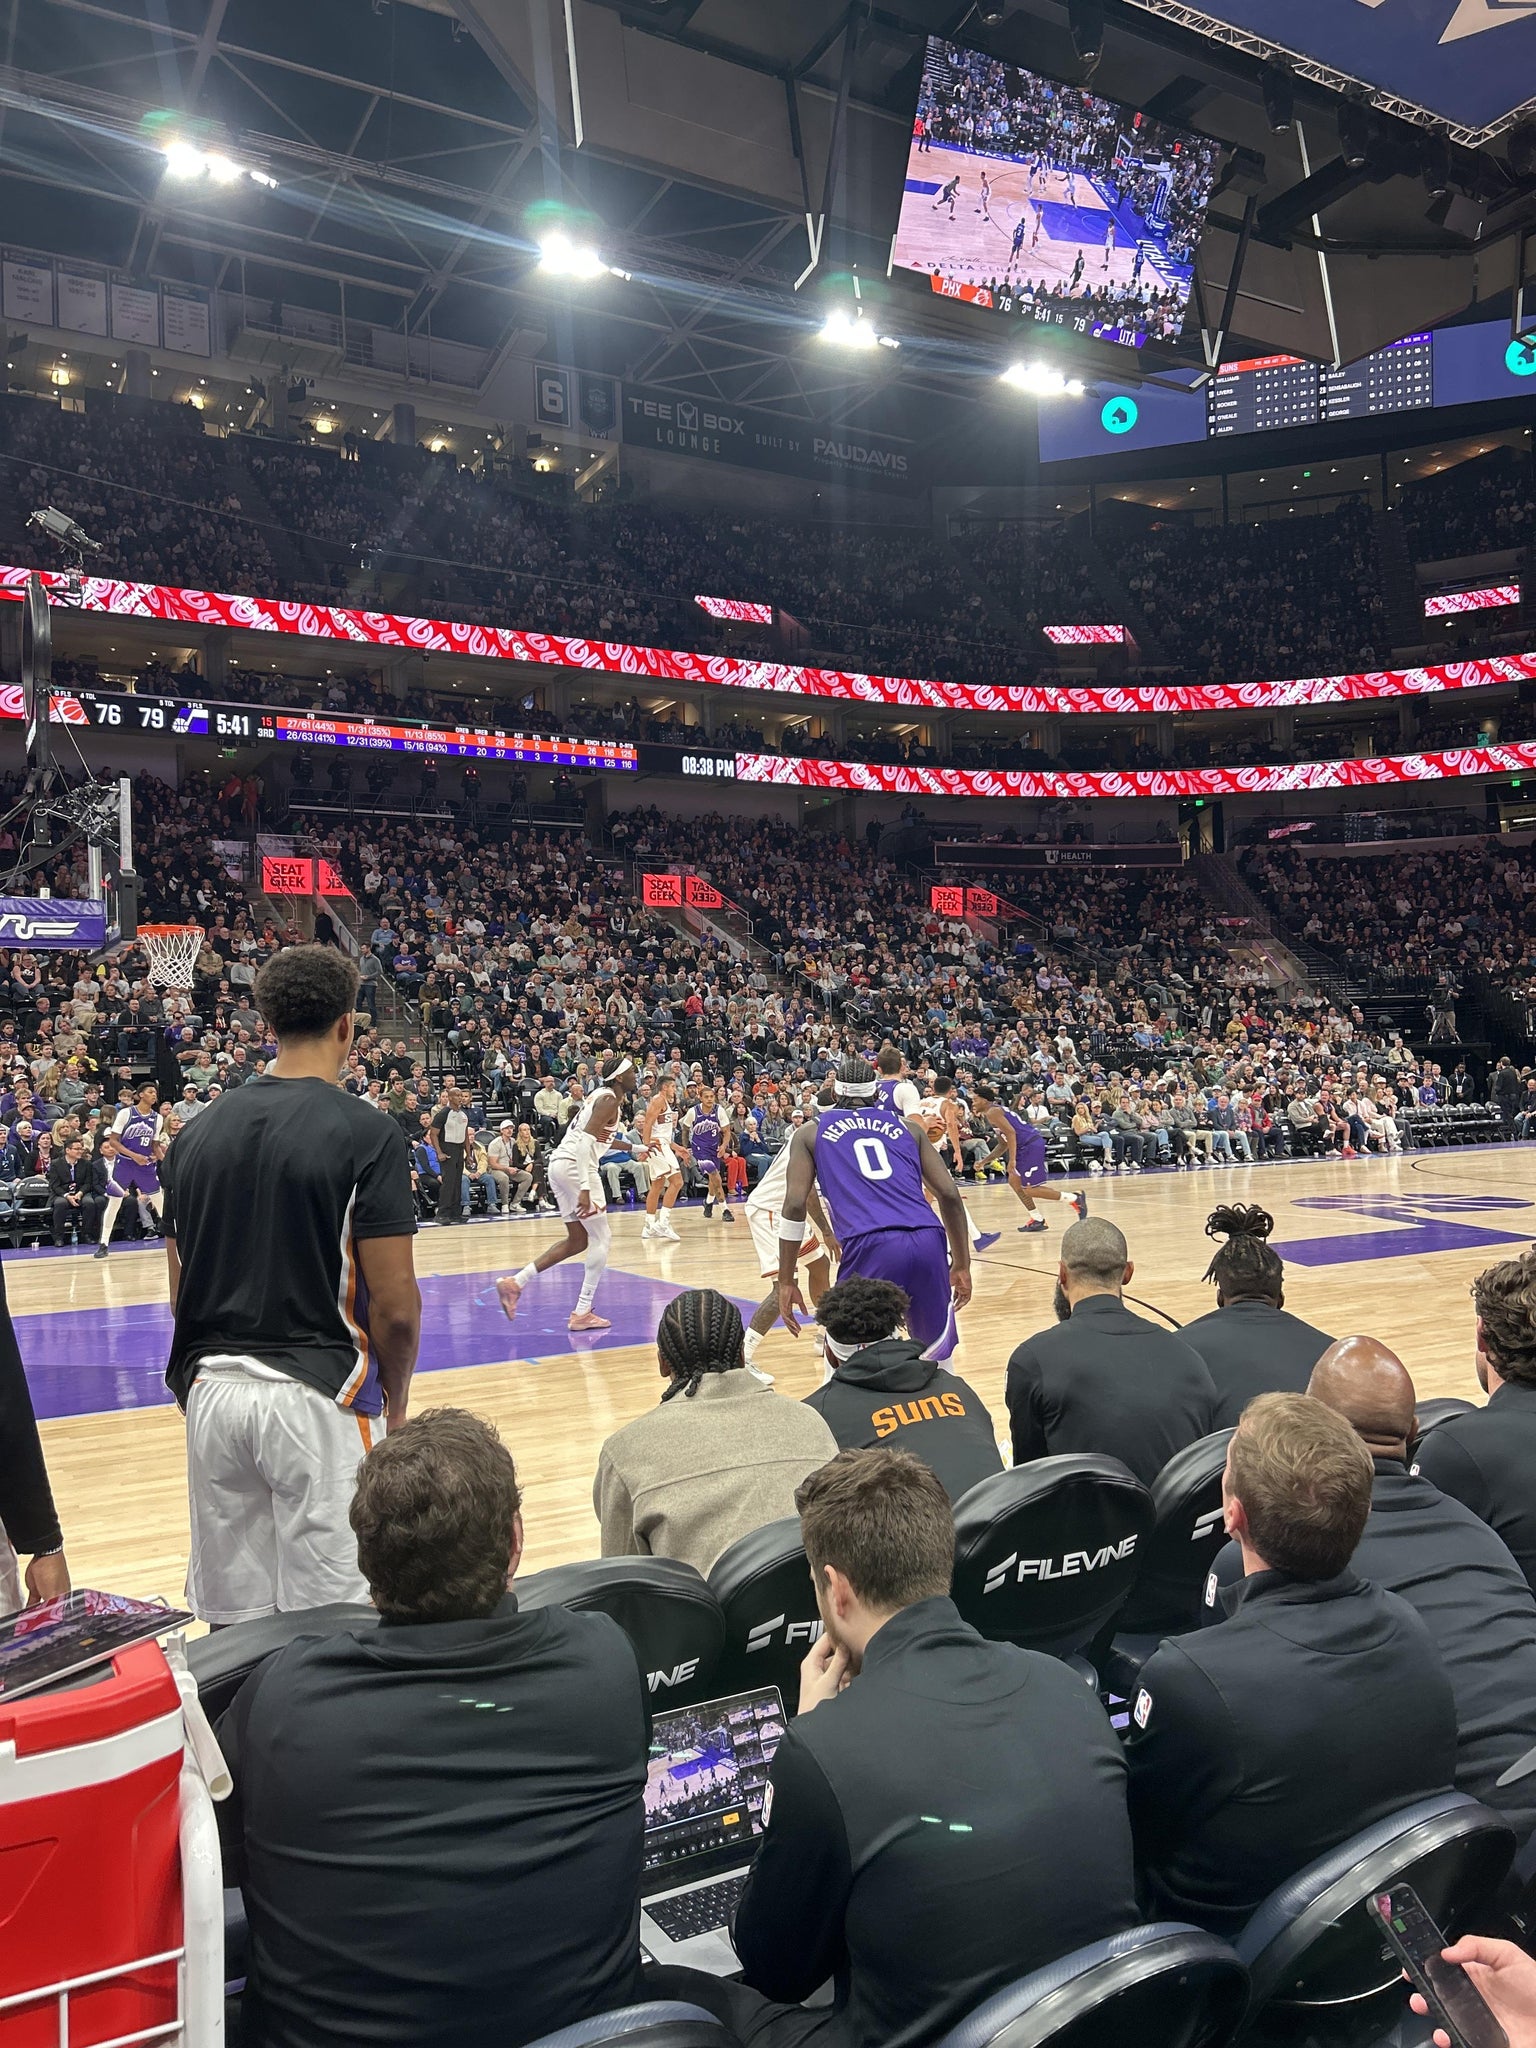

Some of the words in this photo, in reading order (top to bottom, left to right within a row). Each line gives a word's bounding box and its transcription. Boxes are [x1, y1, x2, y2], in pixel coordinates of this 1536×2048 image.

[927, 262, 975, 270] DELTA
[980, 265, 1026, 274] CENER
[942, 280, 962, 297] PHX
[999, 296, 1012, 311] 76
[1034, 307, 1051, 322] 5:41
[1055, 314, 1063, 324] 15
[1074, 317, 1086, 332] 79
[1119, 328, 1136, 346] UTA
[542, 379, 563, 414] 6
[628, 397, 672, 420] TEE
[703, 413, 745, 435] BOX
[657, 428, 720, 453] LOUNGE
[755, 433, 783, 449] BUILT
[789, 438, 800, 451] BY
[813, 438, 908, 471] PAUDAVIS
[95, 703, 121, 725] 76
[138, 707, 164, 728] 79
[217, 713, 249, 735] 5:41
[261, 716, 273, 726] 15
[257, 728, 274, 738] 3RD
[287, 719, 311, 729] 27/61
[312, 721, 336, 732] (44%)
[348, 725, 367, 734] 11/31
[368, 727, 391, 737] (35%)
[405, 731, 423, 739] 11/13
[514, 740, 524, 748] 22
[286, 731, 313, 741] 26/63
[314, 733, 336, 744] (41%)
[347, 736, 368, 746] 12/31
[370, 737, 392, 749] (39%)
[404, 741, 424, 750] 15/16
[425, 742, 448, 753] (94%)
[458, 746, 466, 754] 17
[477, 748, 487, 756] 20
[496, 749, 506, 757] 37
[515, 751, 523, 759] 18
[535, 752, 540, 761] 3
[553, 754, 558, 762] 2
[571, 756, 576, 764] 9
[588, 757, 596, 766] 14
[604, 759, 615, 767] 125
[621, 760, 632, 768] 116
[682, 756, 714, 776] 08:38
[716, 758, 734, 777] PM
[272, 863, 304, 875] SEAT
[270, 876, 305, 889] GEEK
[650, 880, 675, 890] SEAT
[650, 891, 675, 900] GEEK
[936, 902, 958, 911] GEEK
[937, 892, 956, 900] SEAT
[140, 1136, 149, 1146] 19
[822, 1117, 903, 1142] HENDRICKS
[853, 1137, 892, 1180] 0
[1017, 1534, 1138, 1582] FILEVINE
